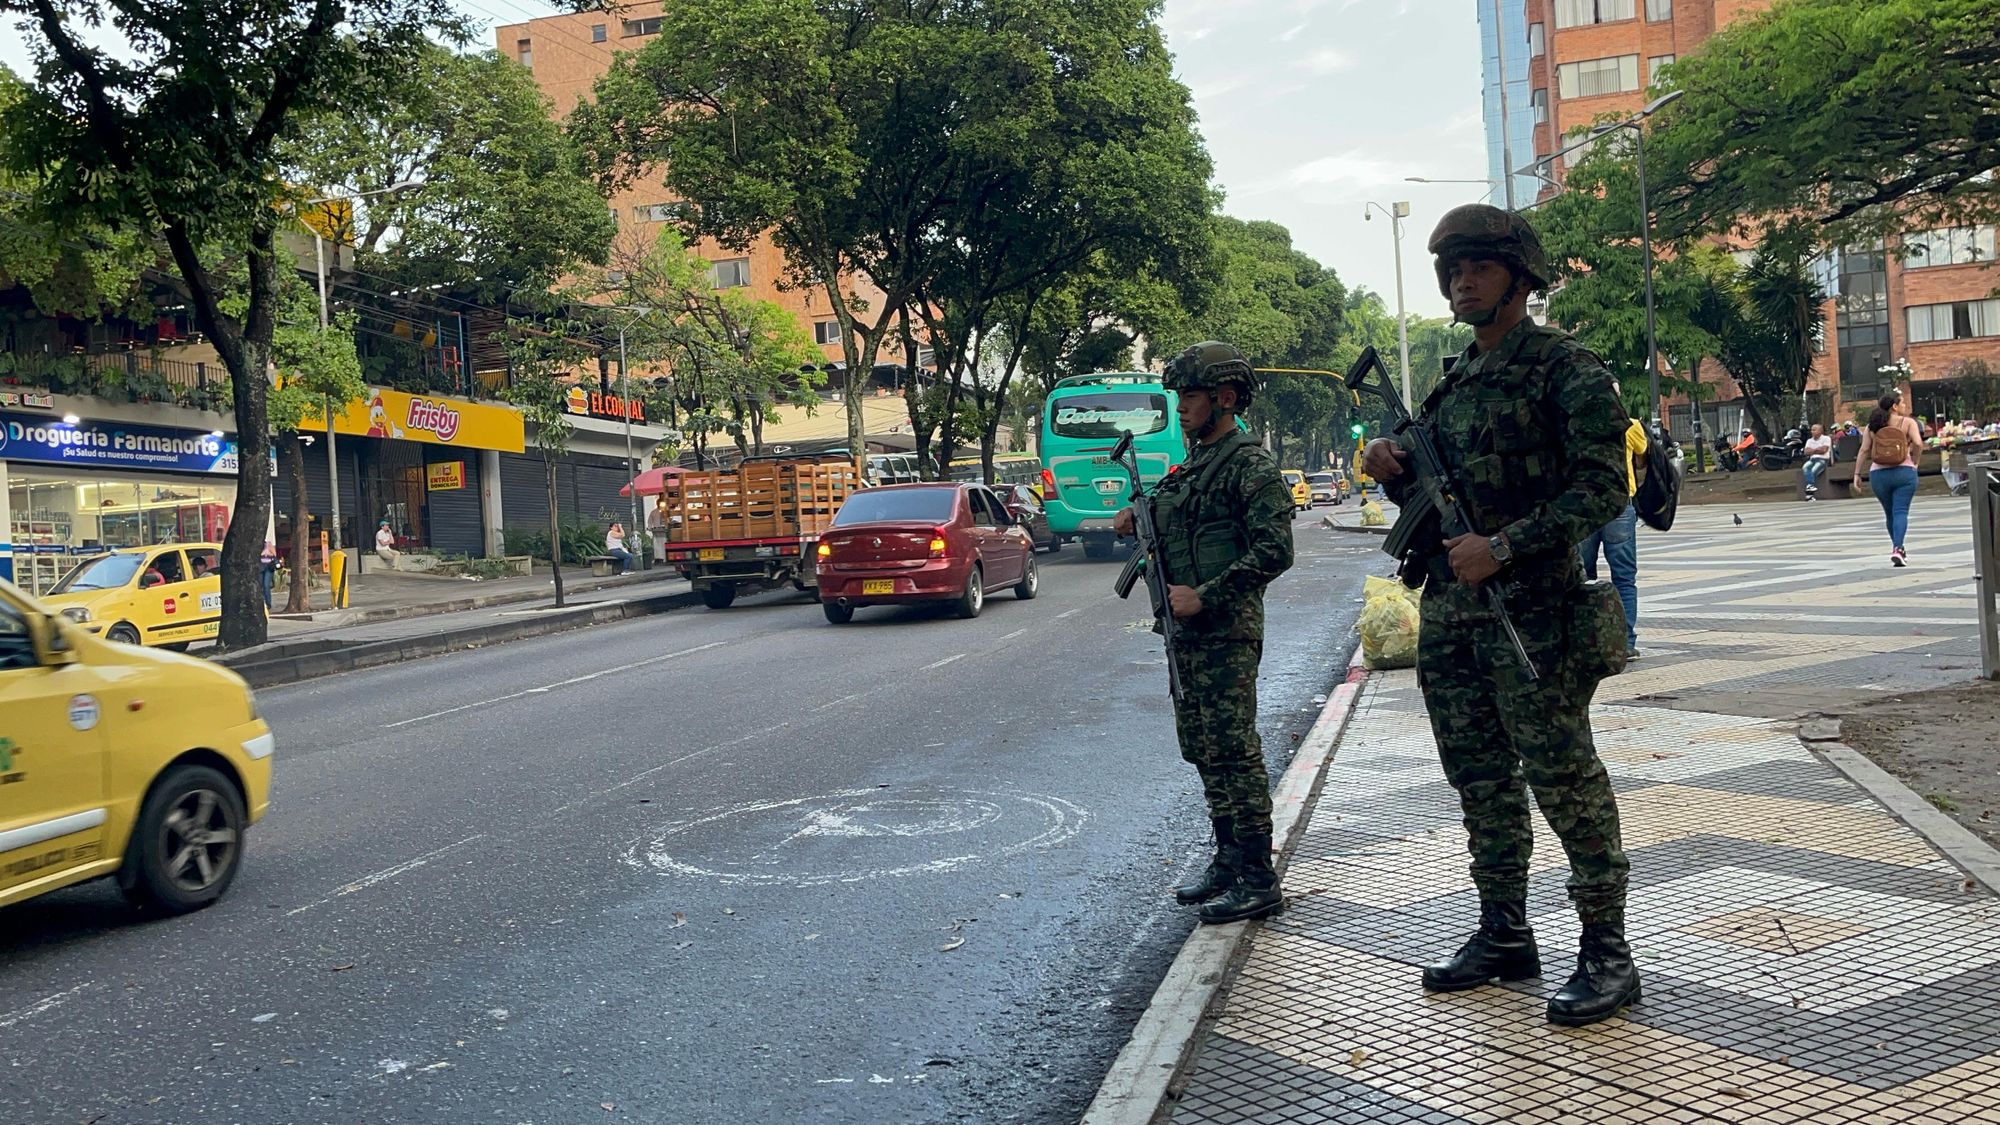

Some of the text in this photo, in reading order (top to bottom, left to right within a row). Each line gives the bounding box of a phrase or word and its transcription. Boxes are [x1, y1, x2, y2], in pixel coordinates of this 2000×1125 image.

[592, 392, 605, 414] EL
[408, 399, 459, 440] Frisby
[9, 422, 219, 456] Droguería Farmanorte
[76, 448, 97, 457] Salud
[107, 451, 135, 460] nuestro
[135, 453, 179, 463] compromiso!
[430, 475, 459, 484] ENTREGA
